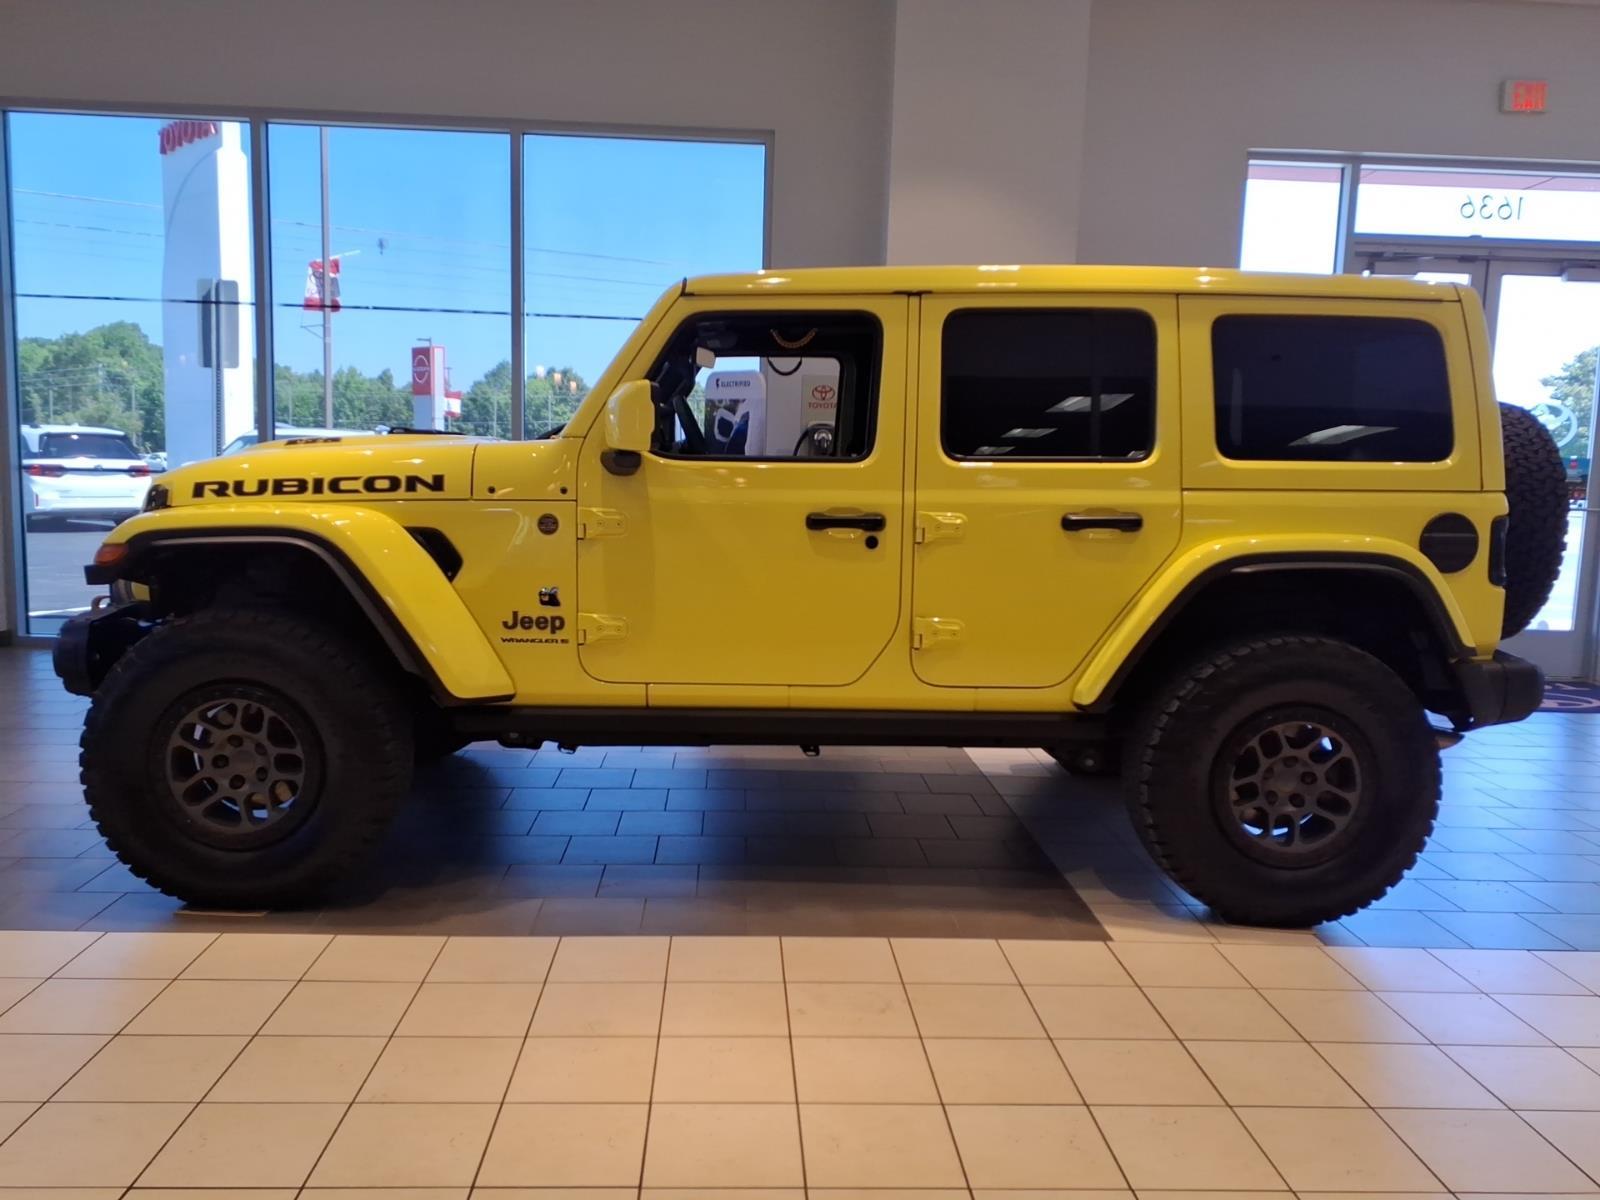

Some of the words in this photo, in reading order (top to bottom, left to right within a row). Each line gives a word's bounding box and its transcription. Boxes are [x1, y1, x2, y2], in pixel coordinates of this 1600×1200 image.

[1513, 82, 1547, 110] EXIT
[158, 120, 217, 154] TOYOTA
[192, 474, 445, 499] RUBICON
[502, 611, 566, 635] Jeep
[500, 636, 559, 644] WRANGLER
